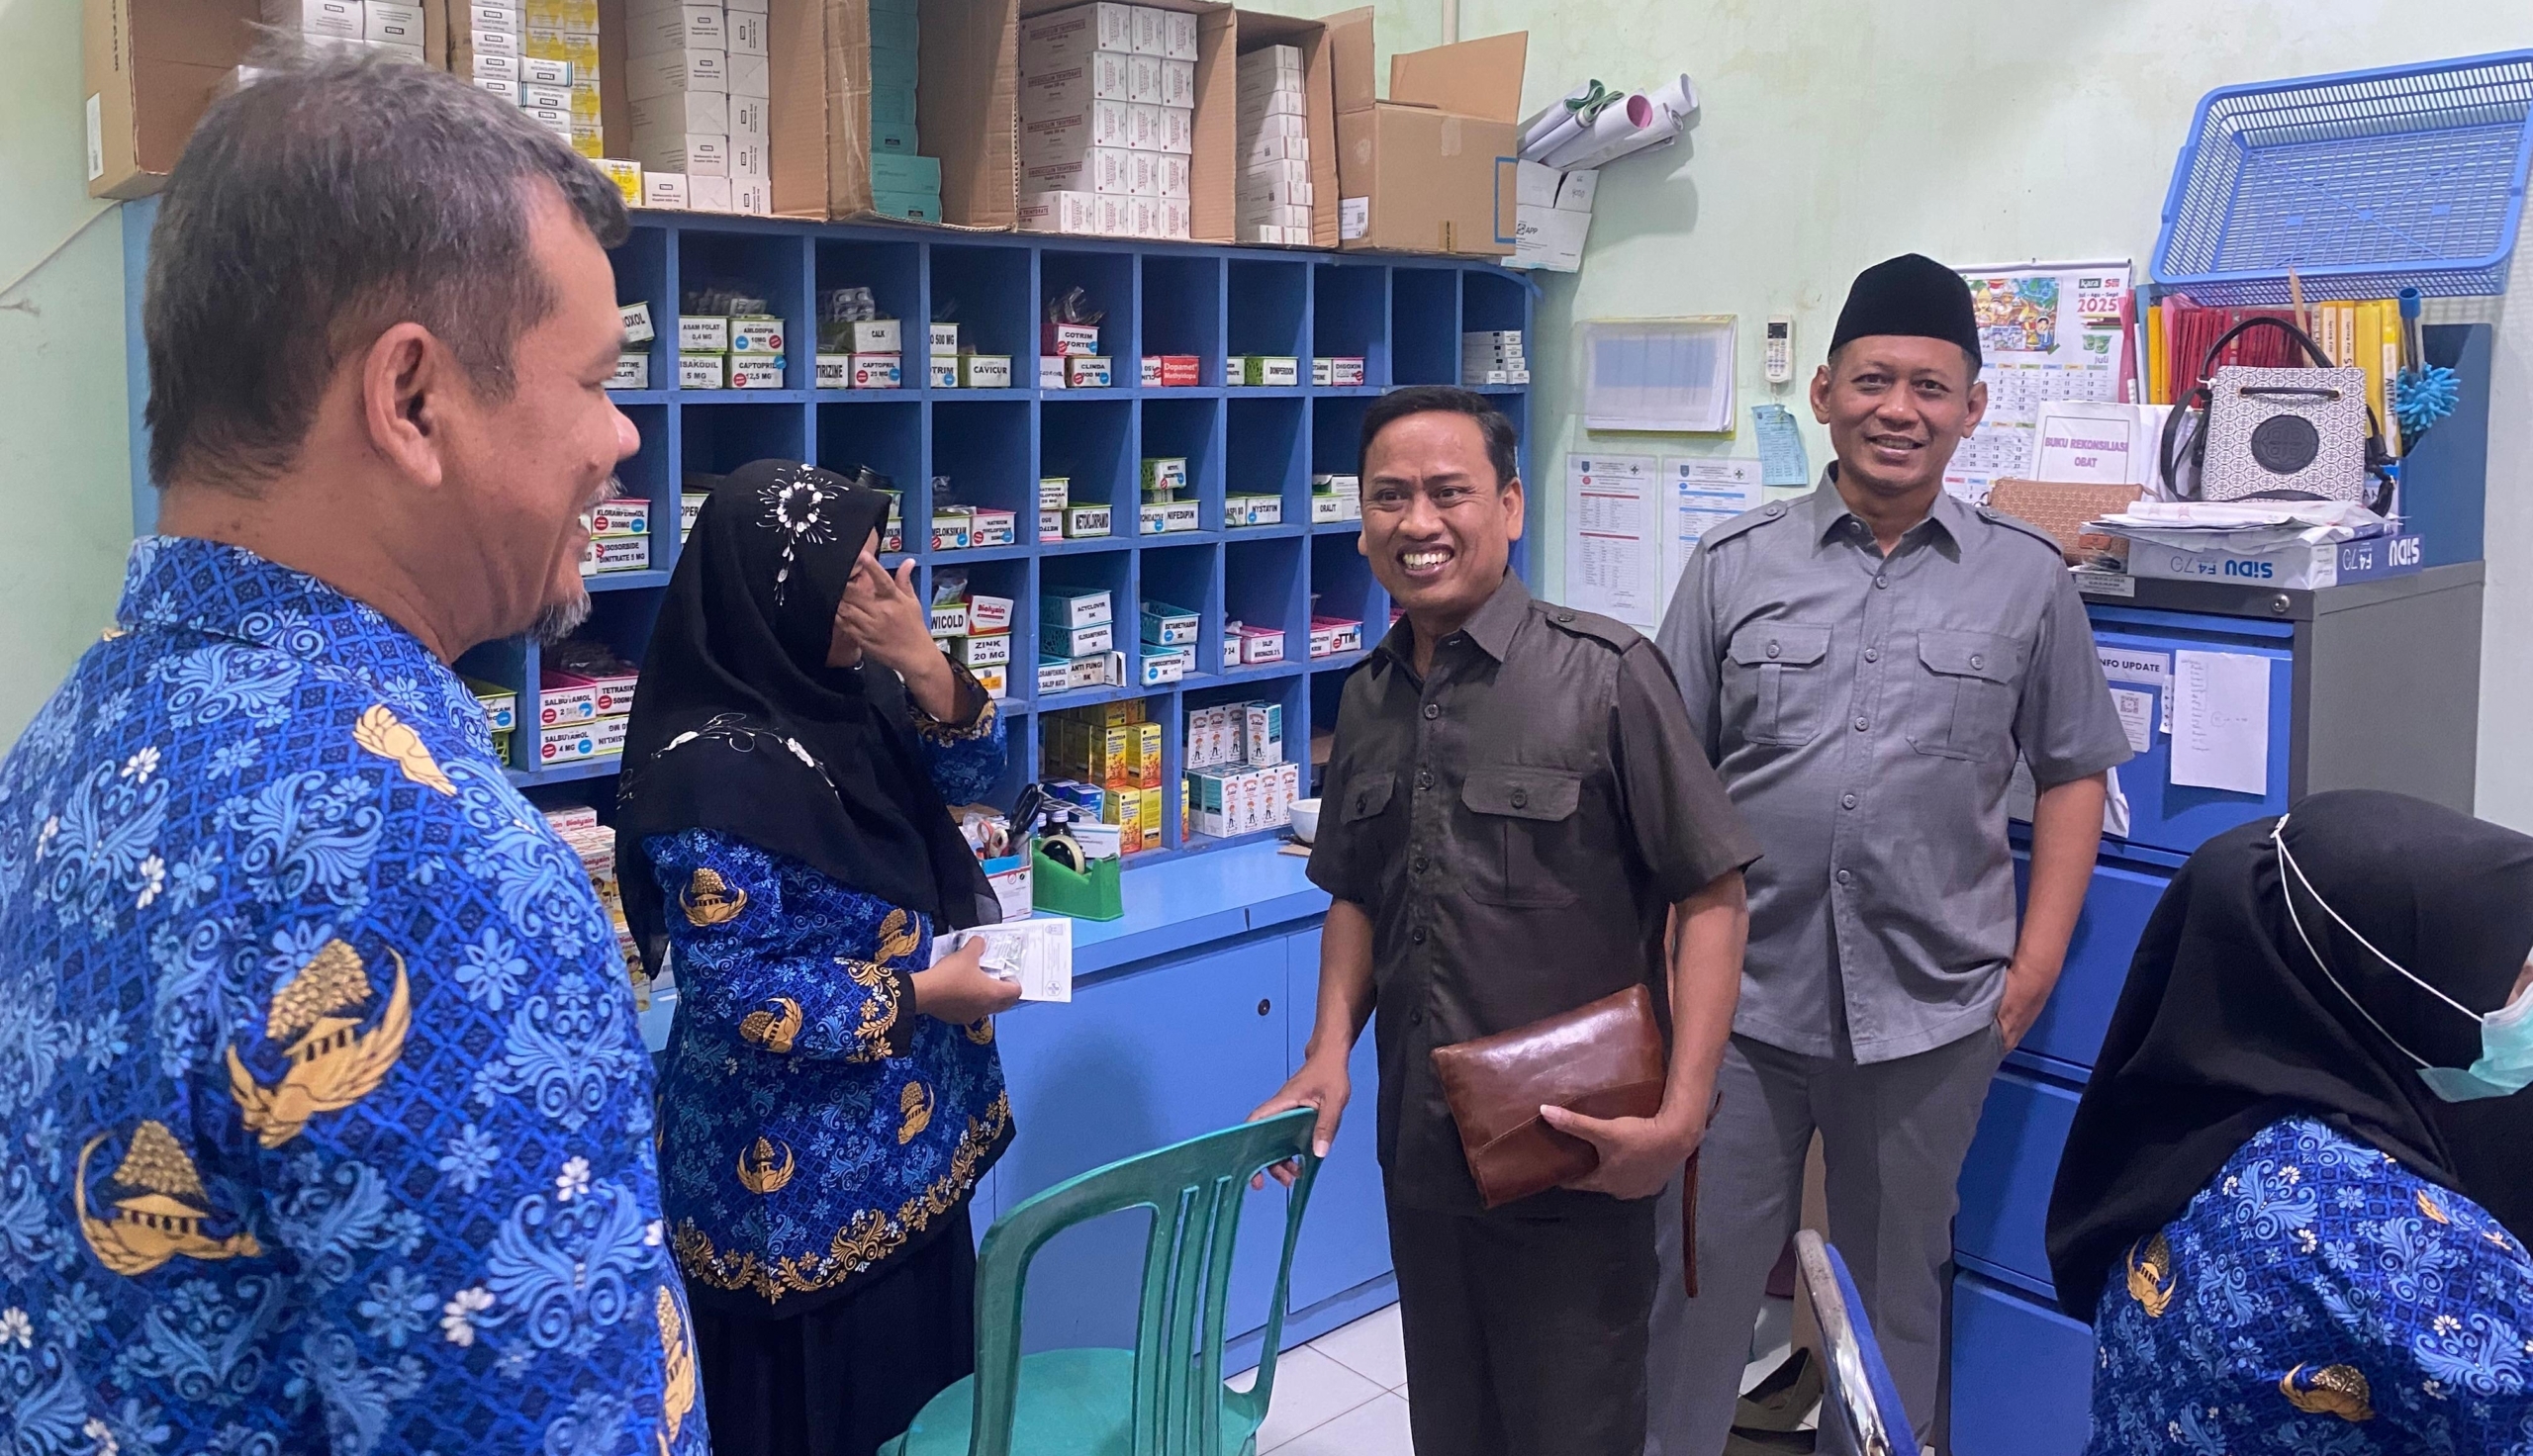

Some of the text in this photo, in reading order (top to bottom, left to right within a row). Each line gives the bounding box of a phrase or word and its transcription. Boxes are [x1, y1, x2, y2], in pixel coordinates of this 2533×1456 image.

[1526, 227, 1538, 235] APP
[2077, 298, 2117, 312] 2025
[2095, 356, 2109, 364] Juli
[974, 366, 1008, 375] CAVICUR
[2045, 437, 2128, 453] BUKU REKONSILIASI
[2074, 457, 2098, 468] OBAT
[1319, 504, 1337, 513] ORALIT
[1167, 511, 1195, 520] NIFEDIPIN
[605, 543, 640, 551] ISOSORBIDE
[600, 554, 630, 563] DINITRATE
[2359, 553, 2372, 570] F4
[2198, 563, 2216, 575] F4
[1077, 602, 1106, 612] ACYCLOVIR
[975, 640, 1001, 649] ZINK
[989, 651, 1005, 659] MG
[1071, 661, 1103, 672] ANTI FUNGI
[2122, 660, 2160, 673] UPDATE
